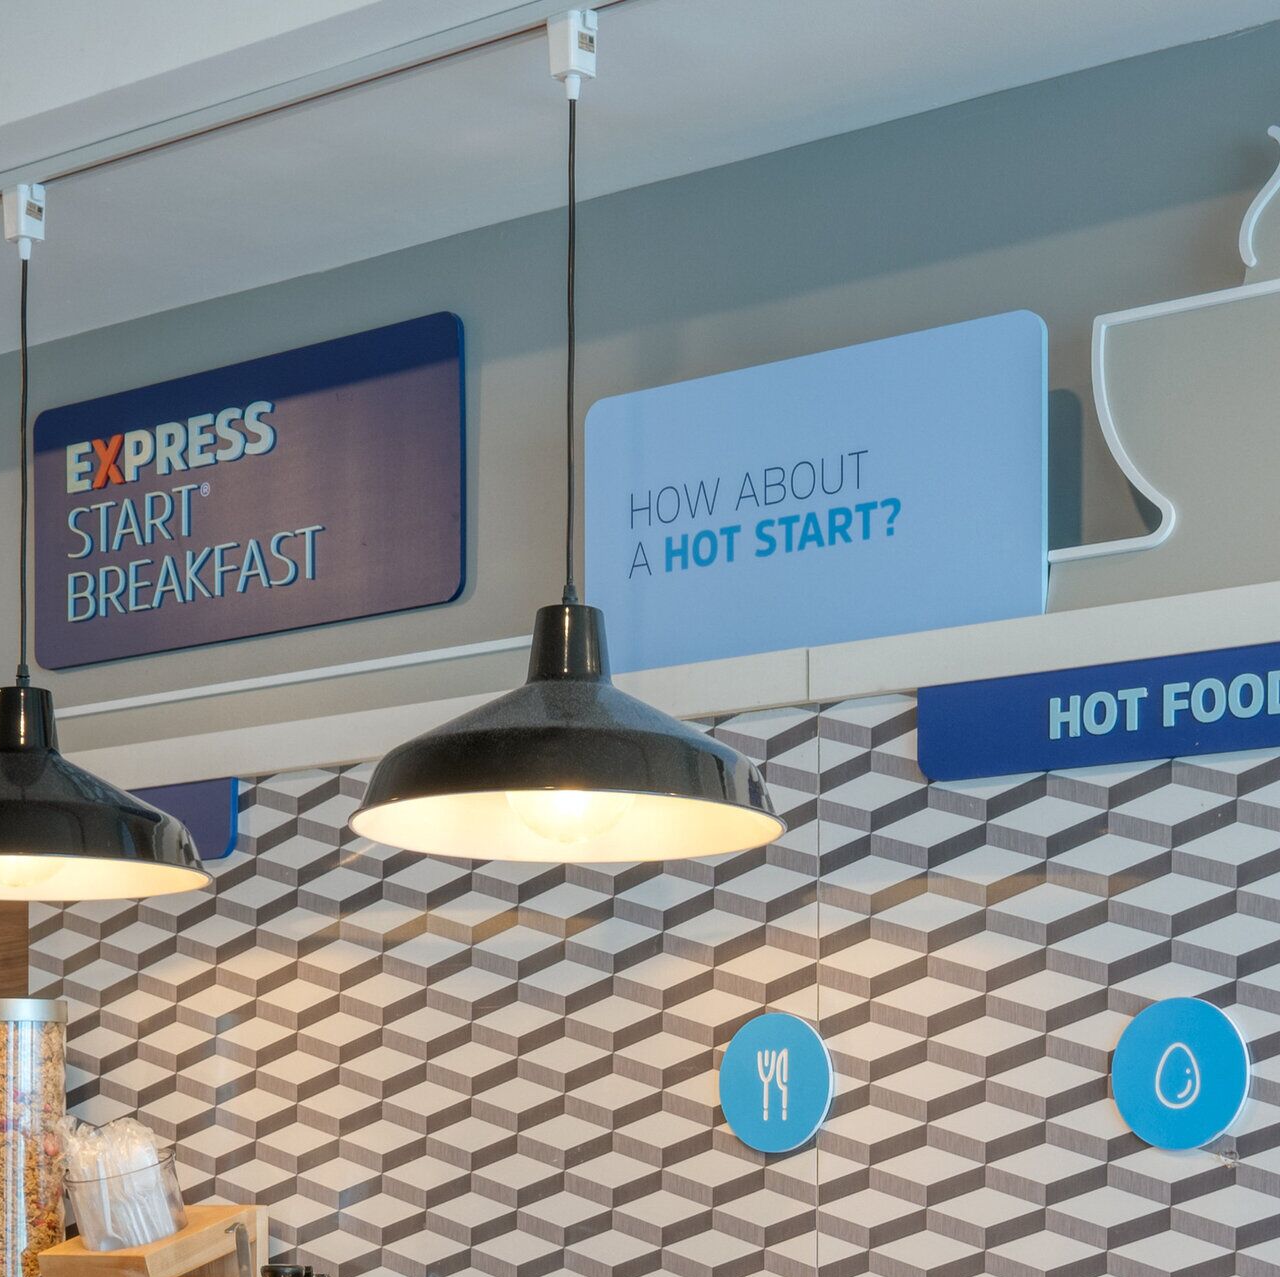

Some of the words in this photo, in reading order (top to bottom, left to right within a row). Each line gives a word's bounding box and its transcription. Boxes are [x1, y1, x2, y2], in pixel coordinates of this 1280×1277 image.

[66, 400, 275, 493] EXPRESS
[629, 477, 720, 529] HOW
[735, 450, 869, 510] ABOUT
[67, 525, 324, 622] BREAKFAST
[628, 541, 652, 579] A
[664, 525, 741, 573] HOT
[755, 497, 902, 558] START?
[1048, 687, 1148, 740] HOT
